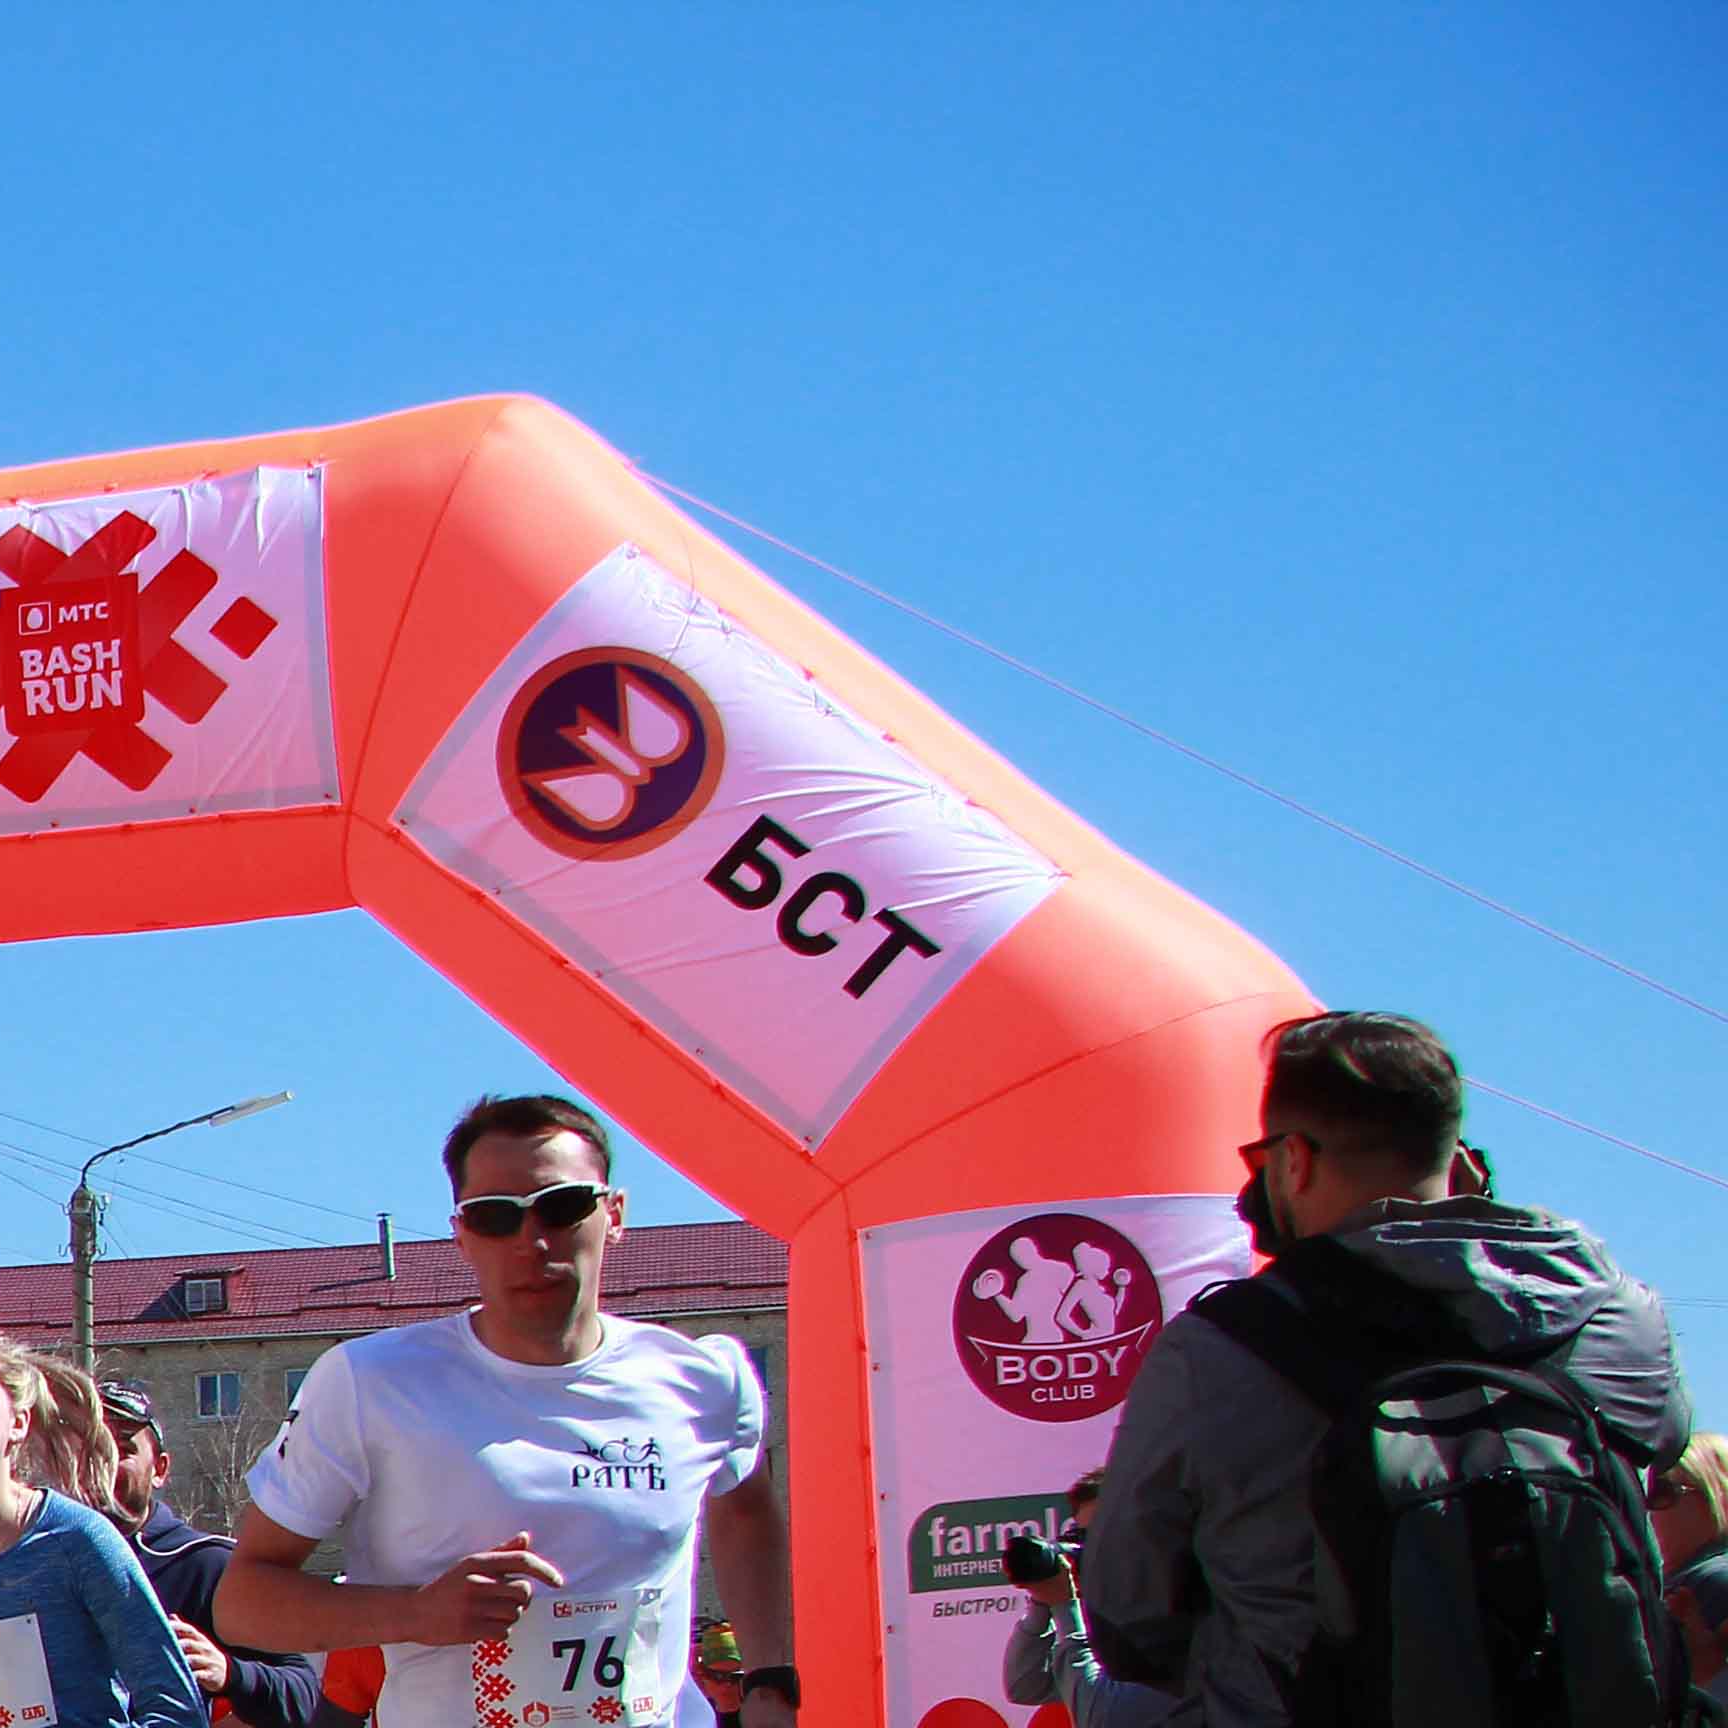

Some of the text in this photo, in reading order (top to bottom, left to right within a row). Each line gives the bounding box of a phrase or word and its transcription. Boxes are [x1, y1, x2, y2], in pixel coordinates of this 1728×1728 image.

[57, 601, 110, 623] МТС
[18, 638, 122, 679] BASH
[21, 670, 124, 717] RUN
[703, 813, 942, 1001] БСТ
[995, 1345, 1128, 1386] BODY
[1030, 1384, 1097, 1403] CLUB
[574, 1602, 618, 1615] АСТРУМ
[932, 1595, 1017, 1618] БЫСТРО!
[552, 1635, 625, 1692] 76
